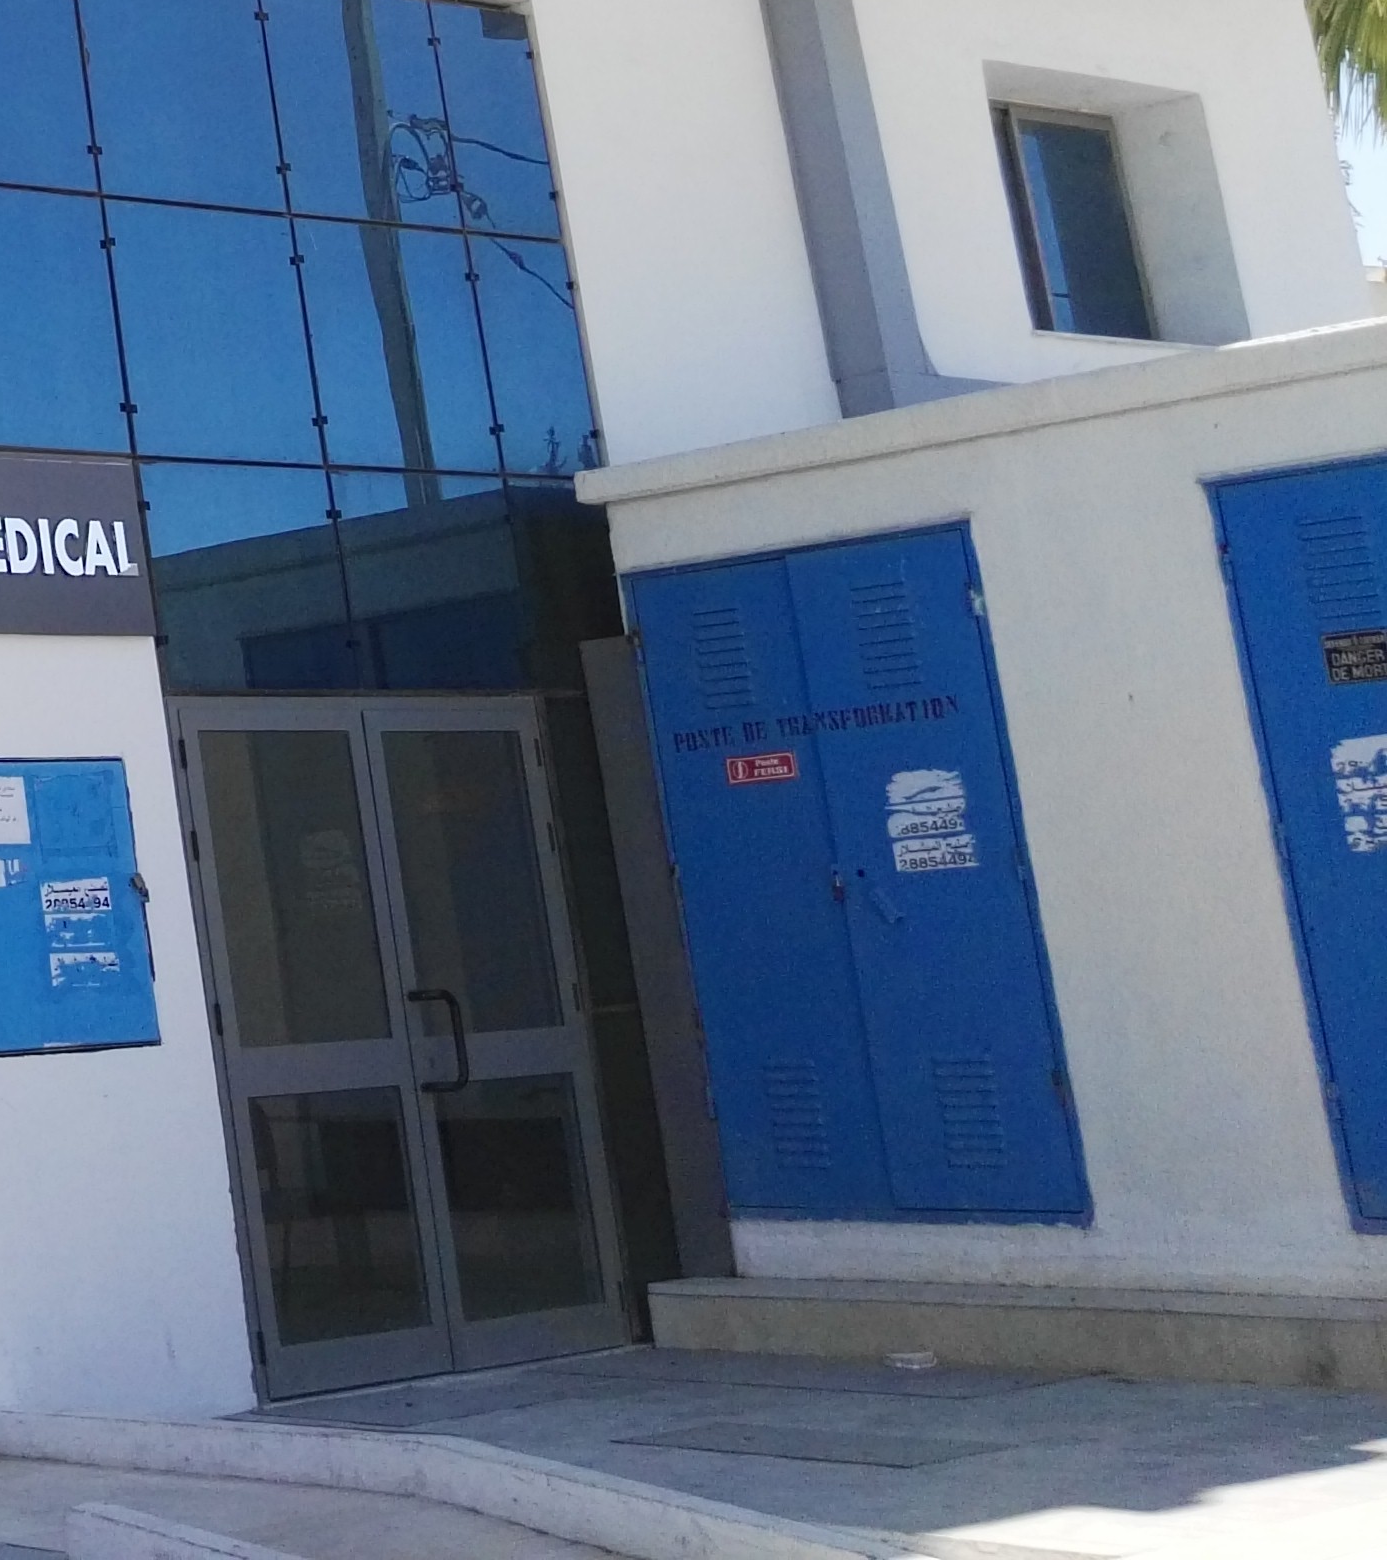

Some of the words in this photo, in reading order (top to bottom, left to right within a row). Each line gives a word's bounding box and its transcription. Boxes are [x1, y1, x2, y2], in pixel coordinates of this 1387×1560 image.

[673, 726, 732, 753] POSTE
[743, 721, 768, 742] DE
[777, 695, 960, 739] TRANSFORMATION
